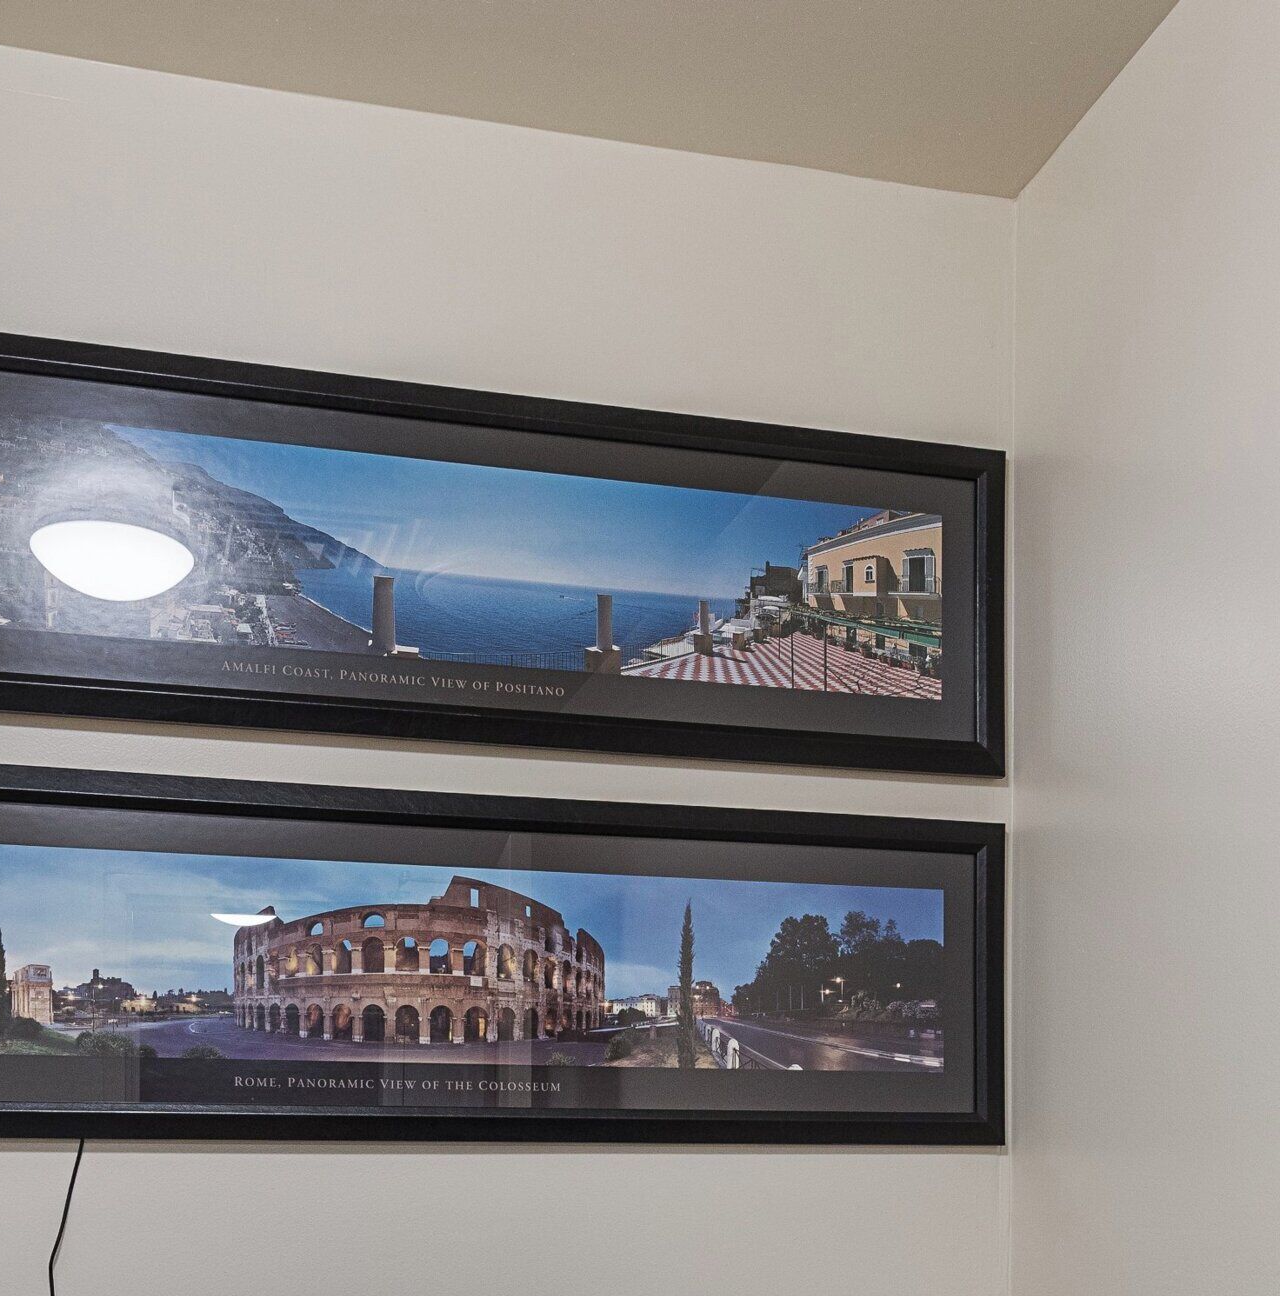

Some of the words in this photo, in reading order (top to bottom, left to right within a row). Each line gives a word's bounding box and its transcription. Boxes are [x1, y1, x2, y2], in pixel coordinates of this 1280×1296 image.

[221, 660, 276, 675] AMALFI
[282, 665, 334, 681] COAST,
[340, 669, 426, 687] PANORAMIC
[431, 676, 468, 690] VIEW
[472, 679, 492, 691] OF
[495, 680, 566, 698] POSITANO
[234, 1076, 282, 1089] ROME,
[287, 1077, 375, 1090] PANORAMIC
[380, 1078, 417, 1091] VIEW
[421, 1079, 440, 1091] OF
[445, 1080, 473, 1091] THE
[478, 1080, 562, 1093] COLOSSEUM
